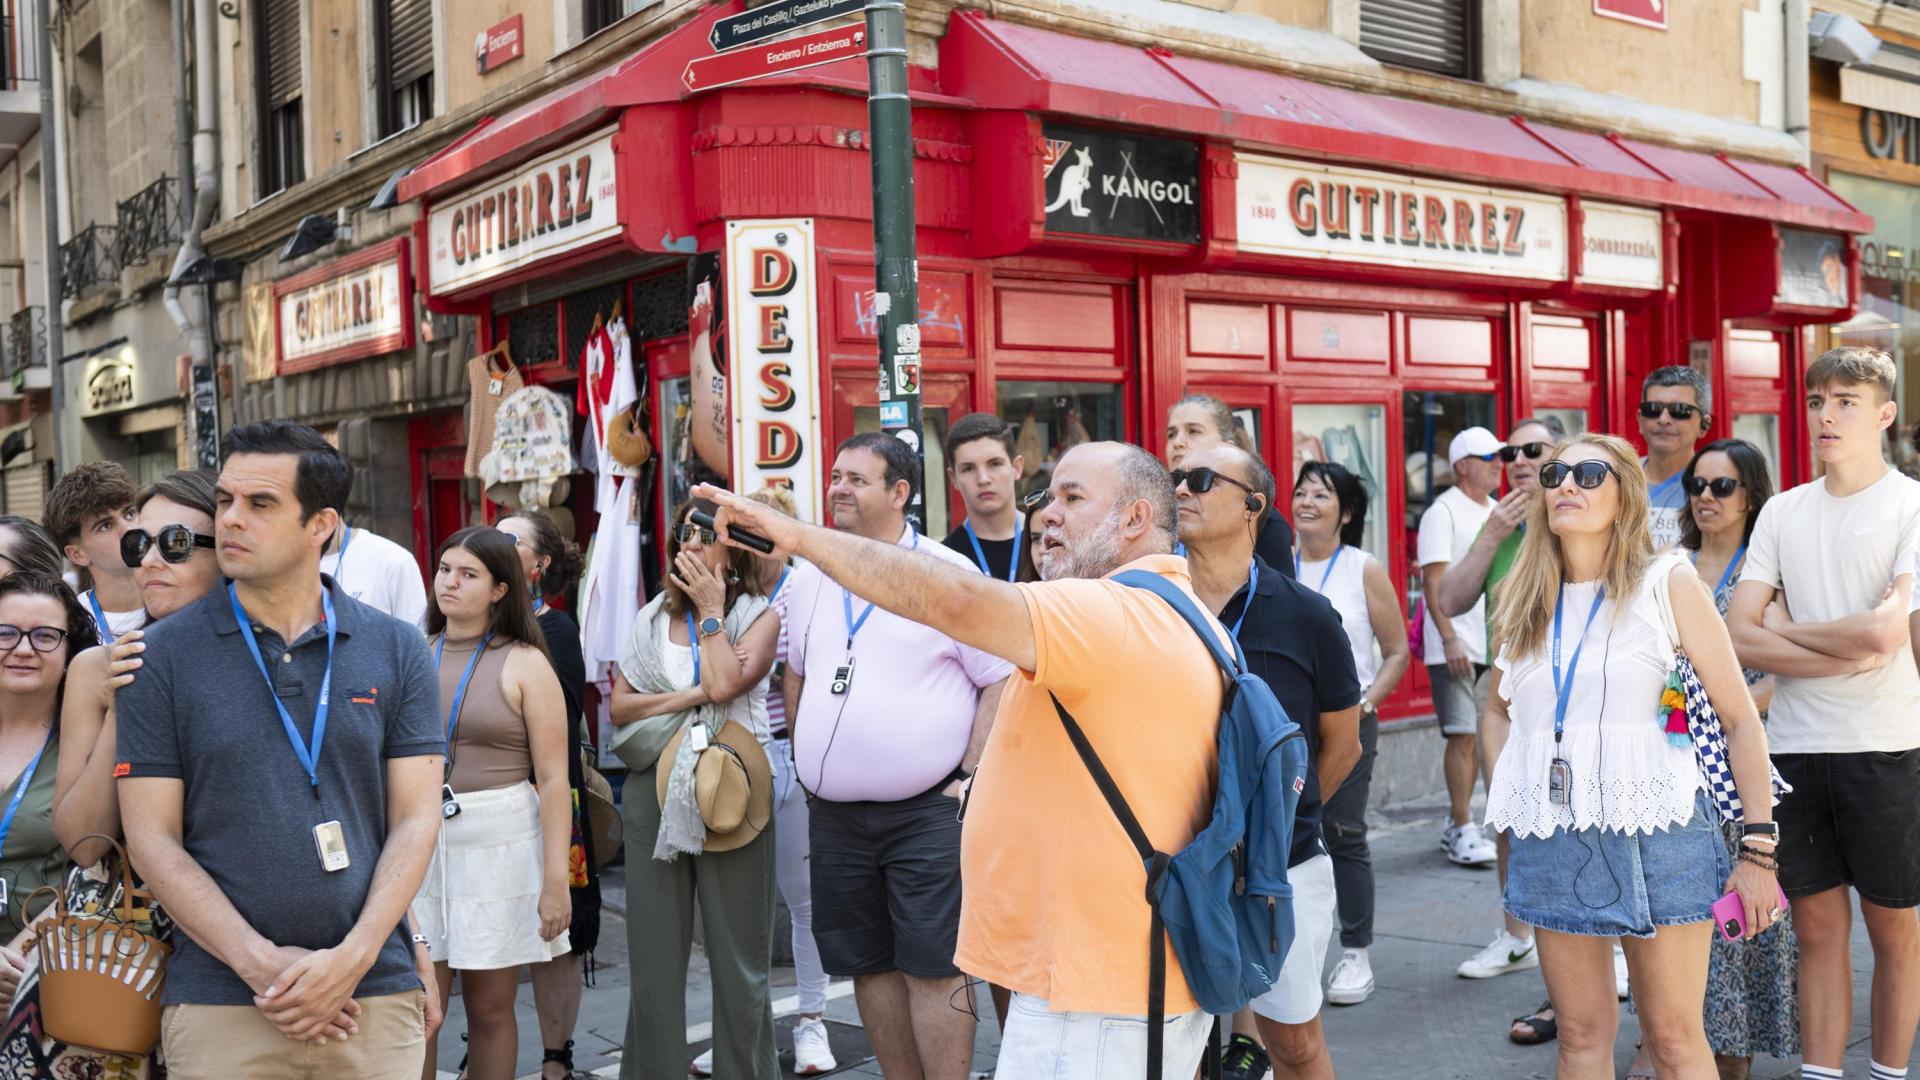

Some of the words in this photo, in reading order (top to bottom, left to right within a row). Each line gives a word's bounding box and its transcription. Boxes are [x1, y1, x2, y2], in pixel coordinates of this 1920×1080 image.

[732, 23, 751, 35] Plaza
[751, 17, 762, 30] del
[763, 10, 788, 26] Castillo
[767, 48, 801, 64] Encierro
[802, 46, 807, 58] /
[808, 37, 851, 55] Entzierroa
[1102, 174, 1194, 205] KANGOL
[452, 154, 593, 266] GUTIERREZ
[1251, 206, 1277, 220] 1840
[1288, 177, 1525, 257] GUTIERREZ
